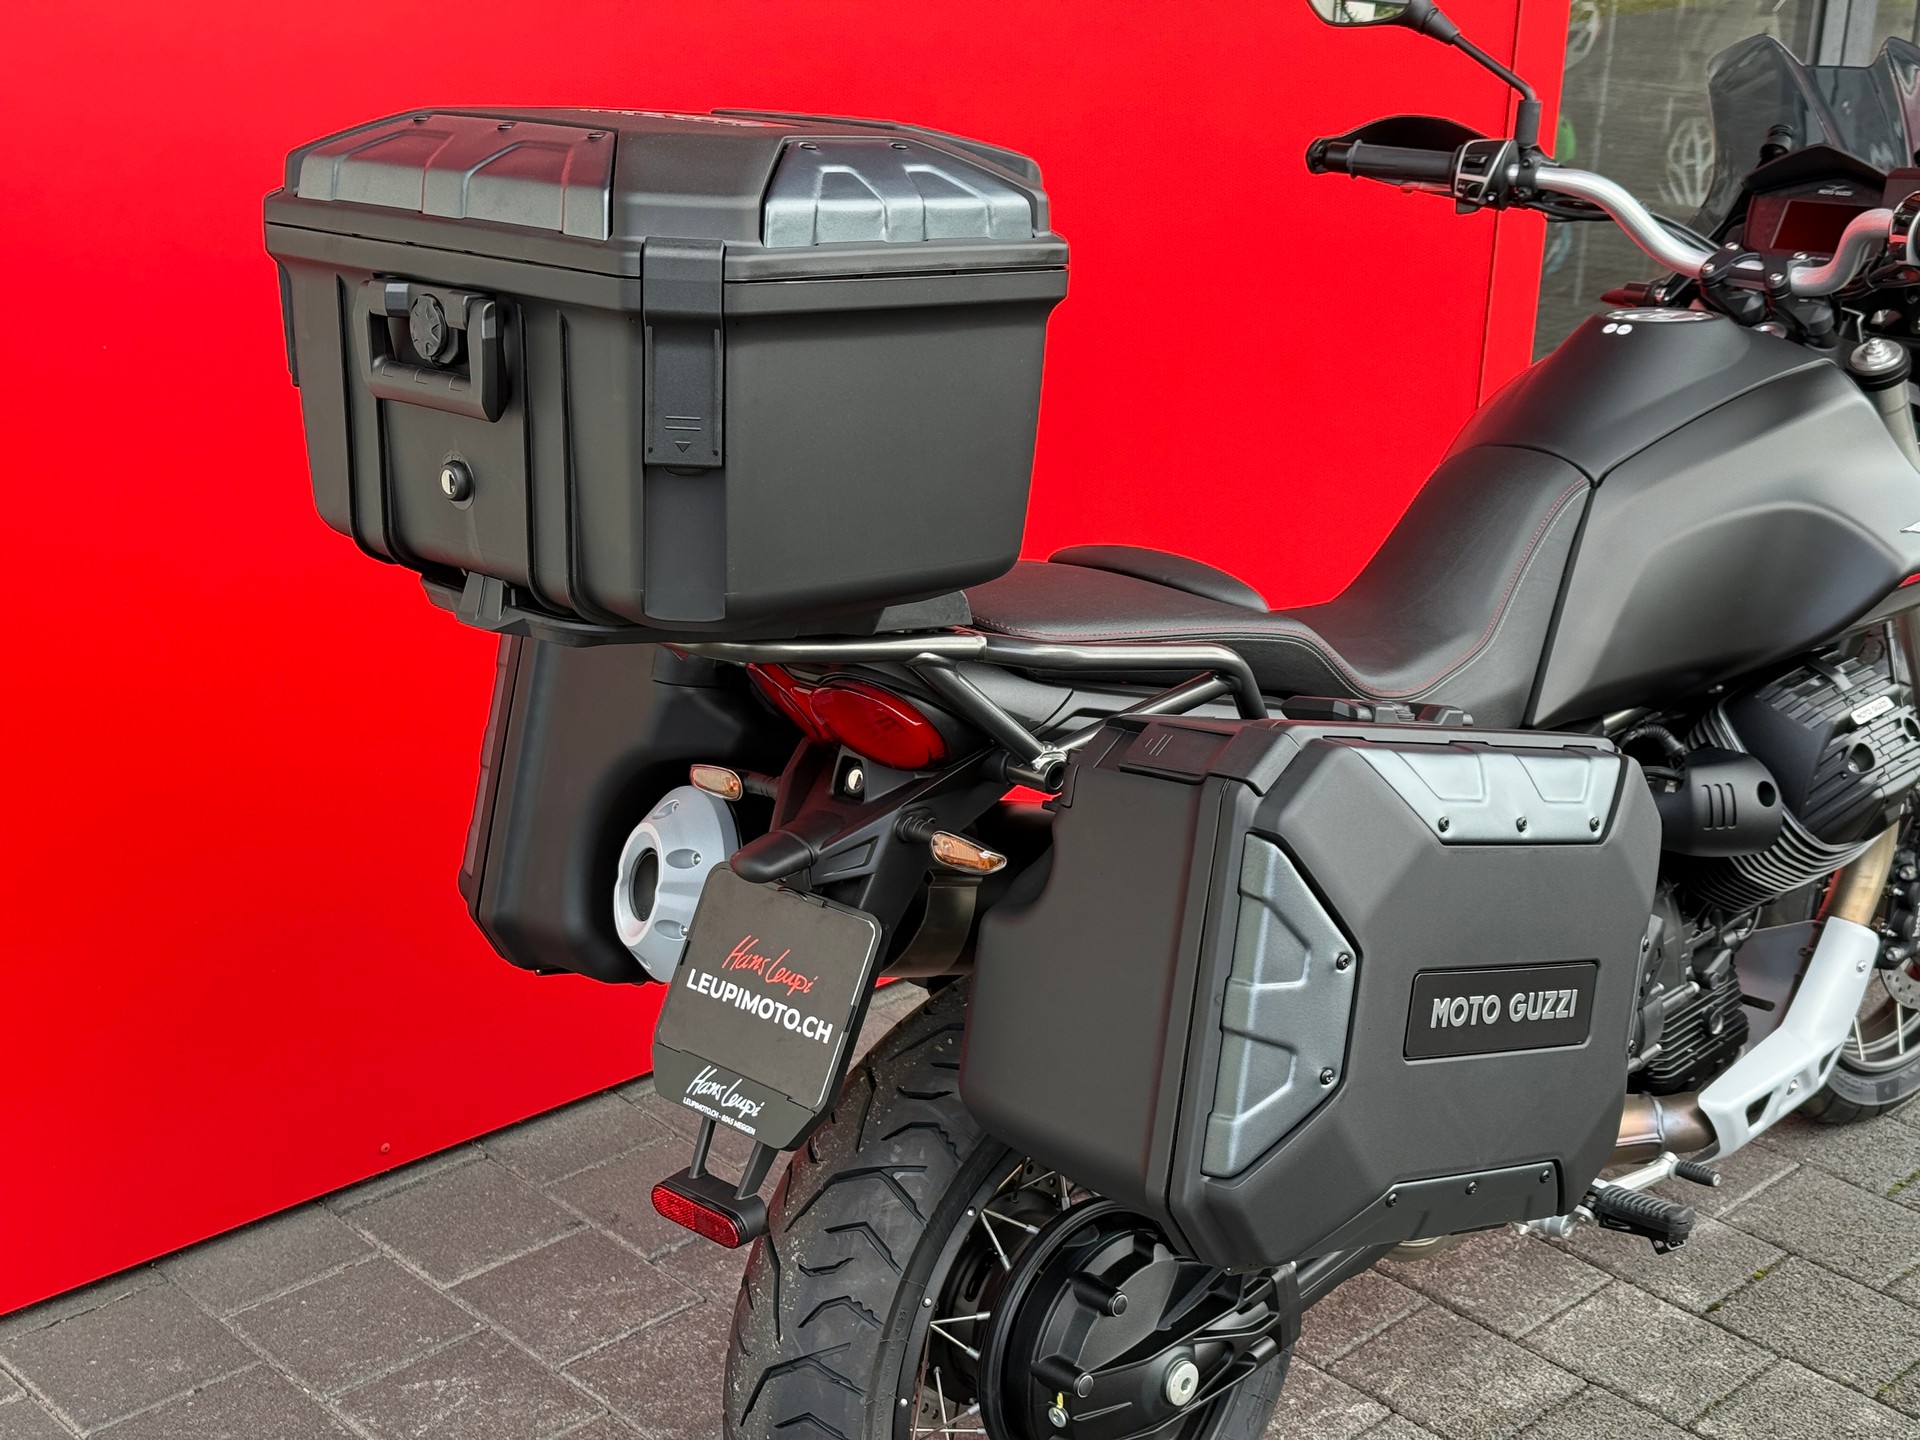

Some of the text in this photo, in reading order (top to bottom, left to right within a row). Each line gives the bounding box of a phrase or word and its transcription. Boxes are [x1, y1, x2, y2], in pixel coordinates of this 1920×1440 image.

[721, 934, 819, 996] Hans Leupi
[686, 968, 834, 1045] LEUPIMOTO.CH
[1430, 988, 1579, 1029] MOTO GUZZI
[682, 1096, 720, 1119] LEUPIMOTO.CH
[685, 1064, 766, 1119] Hans Leupi
